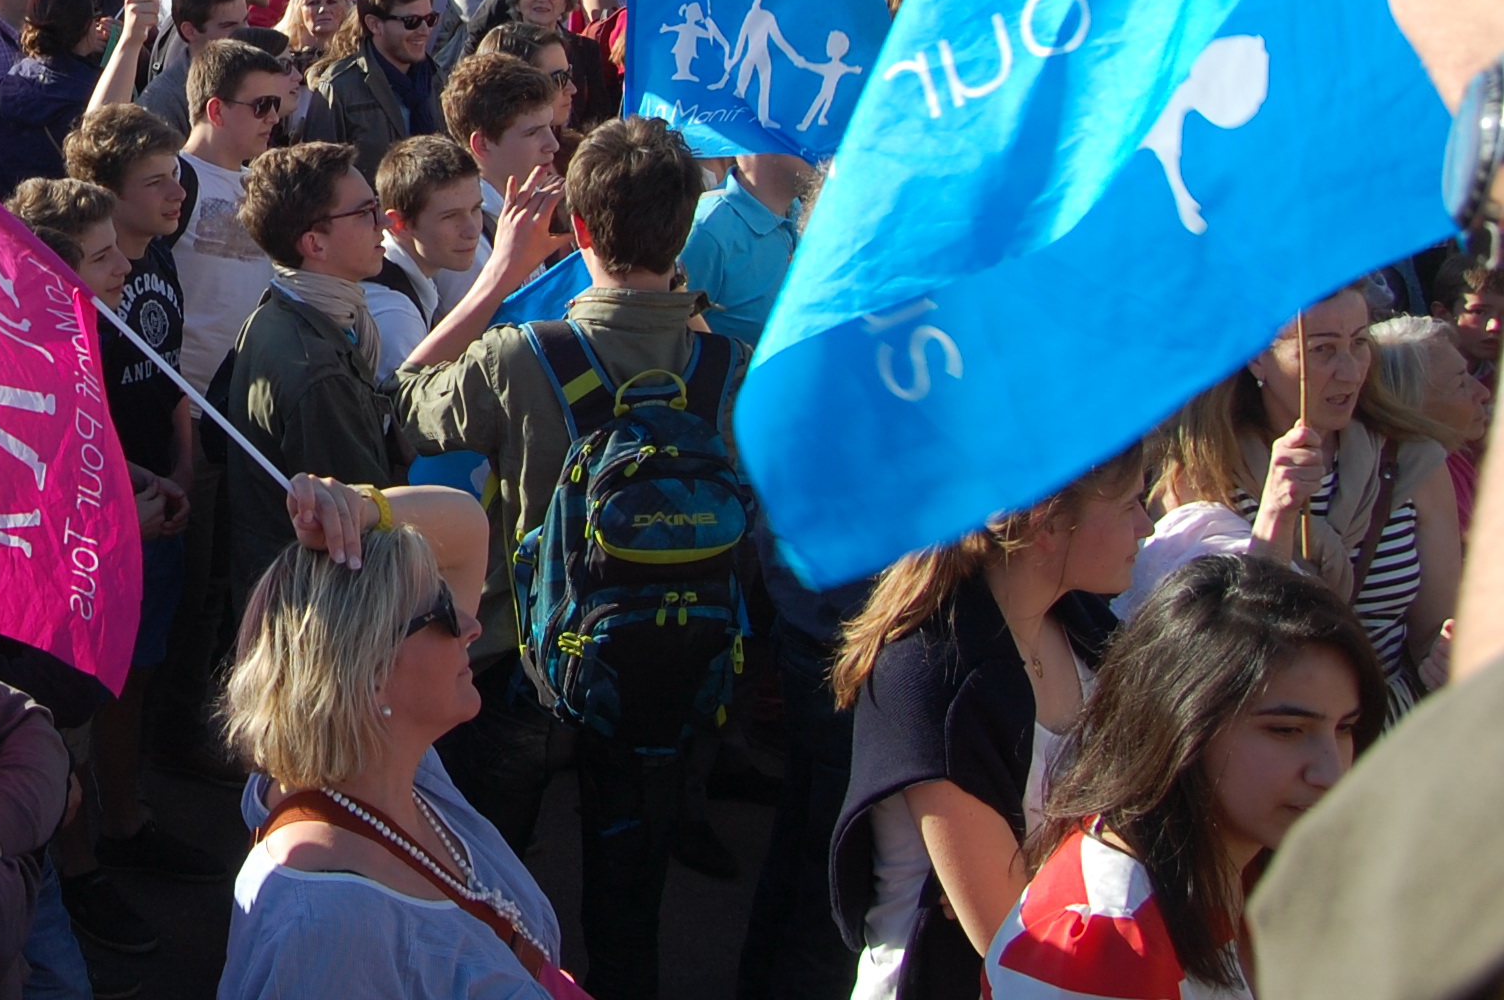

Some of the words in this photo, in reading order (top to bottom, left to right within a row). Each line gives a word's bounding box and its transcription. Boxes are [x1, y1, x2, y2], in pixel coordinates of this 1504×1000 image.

[667, 98, 746, 128] Manif
[117, 273, 182, 326] BERCROMBI
[121, 361, 152, 385] AND
[631, 512, 718, 527] DAKINE
